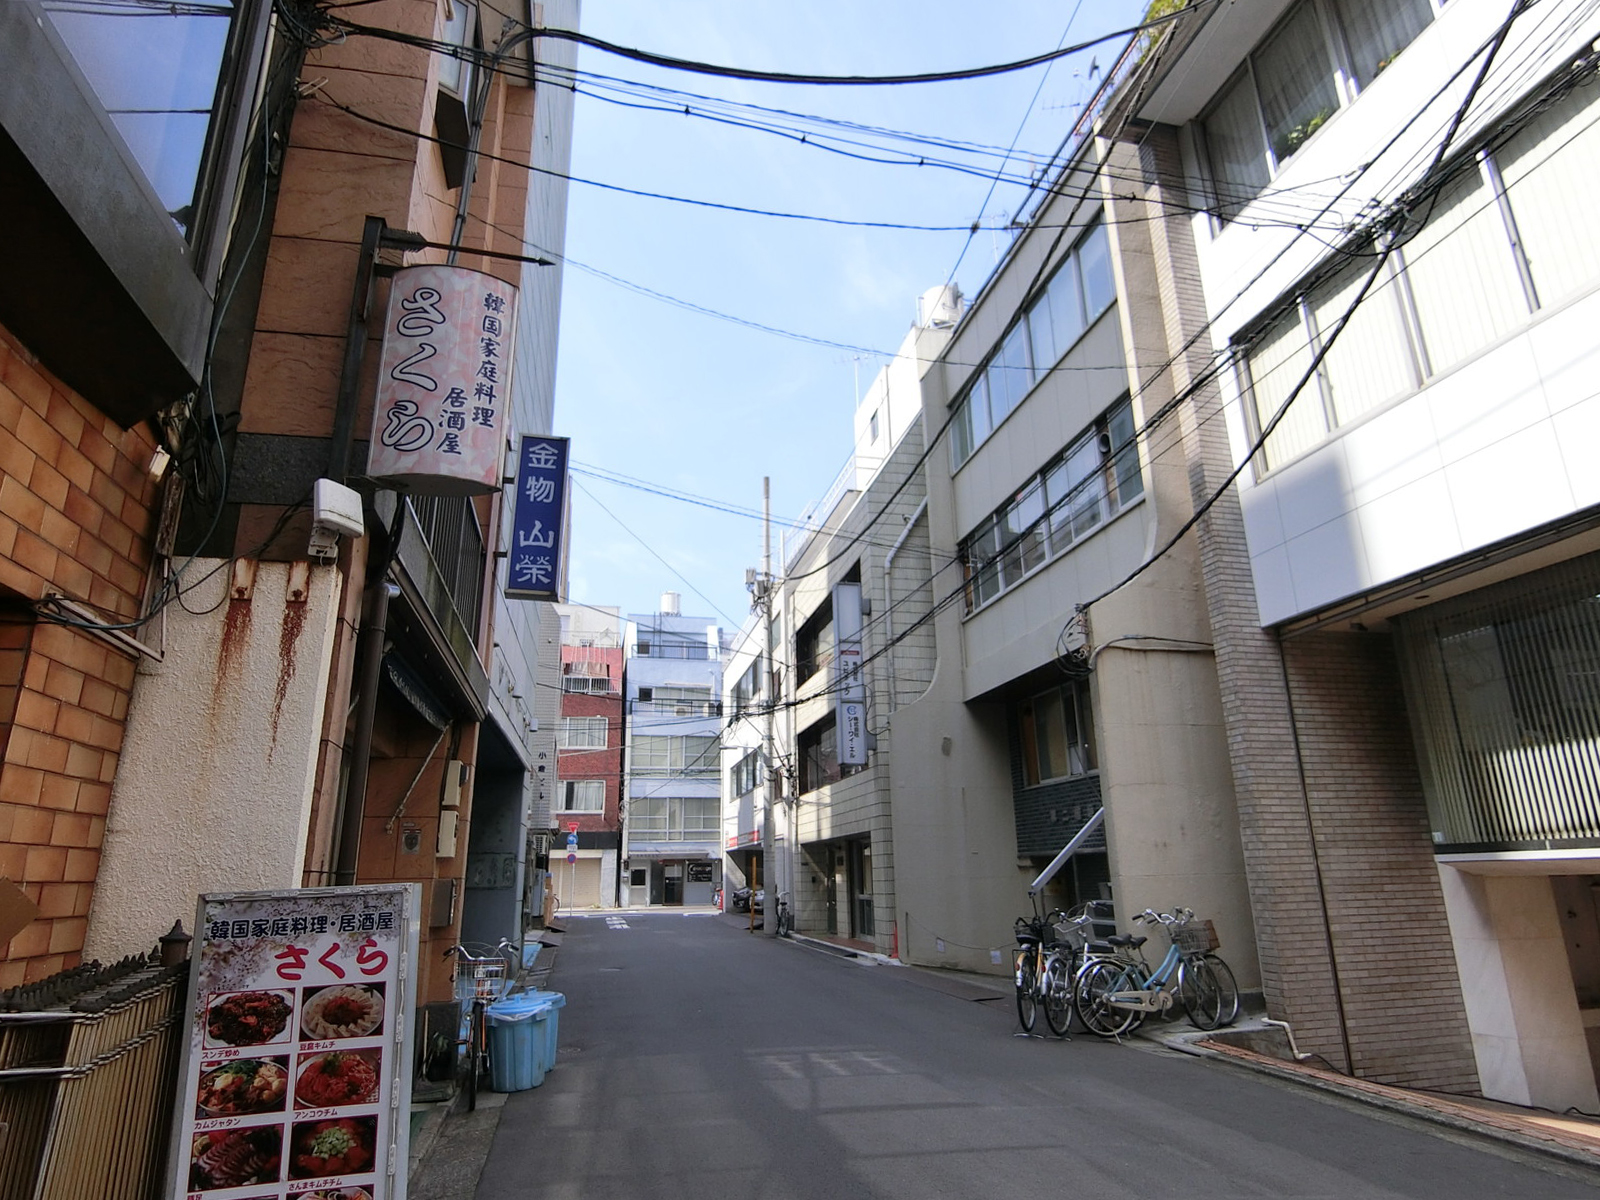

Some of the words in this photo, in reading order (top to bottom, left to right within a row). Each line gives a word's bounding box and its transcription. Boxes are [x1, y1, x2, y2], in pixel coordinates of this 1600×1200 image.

[381, 286, 446, 452] さくら
[471, 291, 506, 429] 韓国家庭料理
[435, 387, 468, 455] 居酒屋
[525, 442, 558, 503] 金物
[210, 912, 394, 941] 韓国家庭料理・居酒屋
[274, 938, 389, 981] さくら
[194, 1118, 241, 1130] カムジャタン
